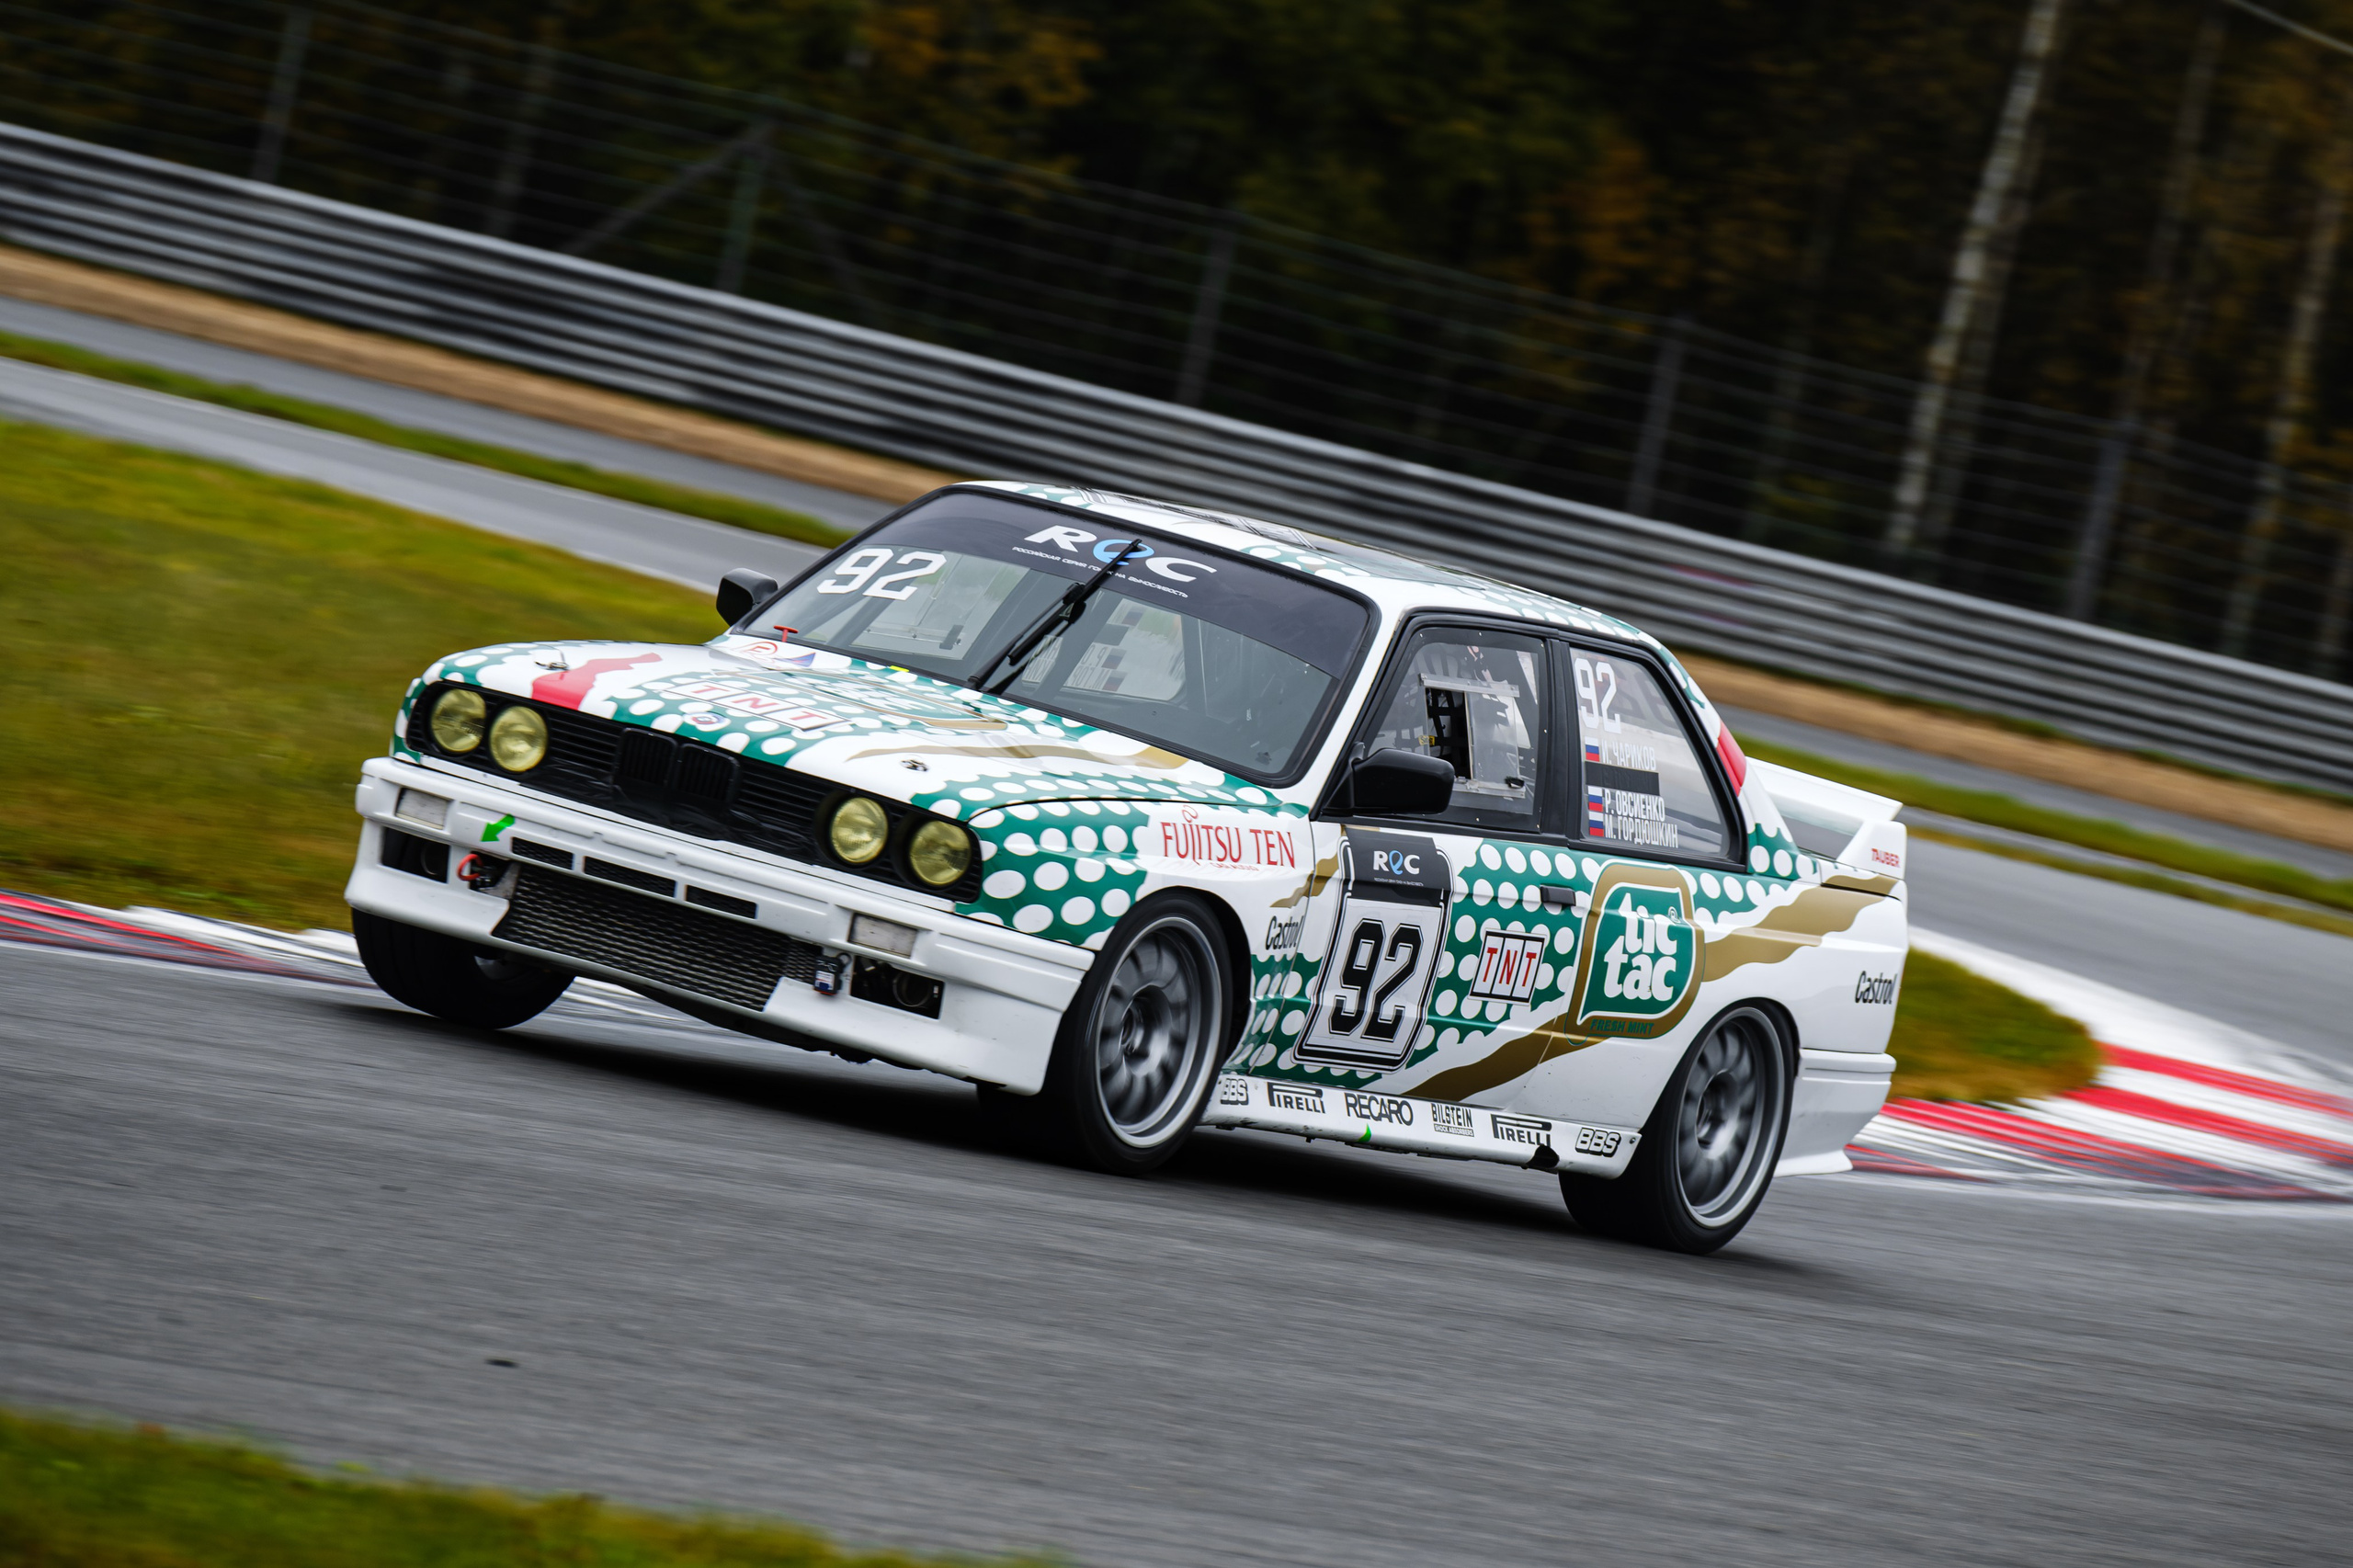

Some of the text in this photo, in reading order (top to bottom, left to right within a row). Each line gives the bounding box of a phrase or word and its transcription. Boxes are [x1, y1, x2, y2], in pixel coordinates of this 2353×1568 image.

[817, 549, 947, 600] 92
[692, 684, 827, 722] TNT
[1574, 657, 1621, 733] 92
[1613, 741, 1655, 771] ЧАРИКОВ
[1604, 788, 1665, 822] Р. ОВСИЕНКО
[1160, 821, 1296, 869] FUJITSU TEN
[1605, 813, 1678, 849] М. ГОРДЮШКИН
[1871, 847, 1900, 868] TAUBER
[1618, 892, 1677, 955] tic
[1329, 918, 1424, 1042] 92
[1482, 947, 1537, 987] TNT
[1604, 935, 1677, 1002] tac
[1855, 971, 1897, 1005] Castrol
[1589, 1018, 1654, 1035] FRESH MINT
[1220, 1078, 1248, 1106] BBS
[1267, 1082, 1325, 1114] PIRELLI
[1344, 1092, 1414, 1127] RECARO
[1431, 1103, 1472, 1128] BILSTEIN
[1435, 1124, 1449, 1132] SHOCK
[1491, 1114, 1552, 1148] PIRELLI
[1575, 1127, 1621, 1157] BBS
